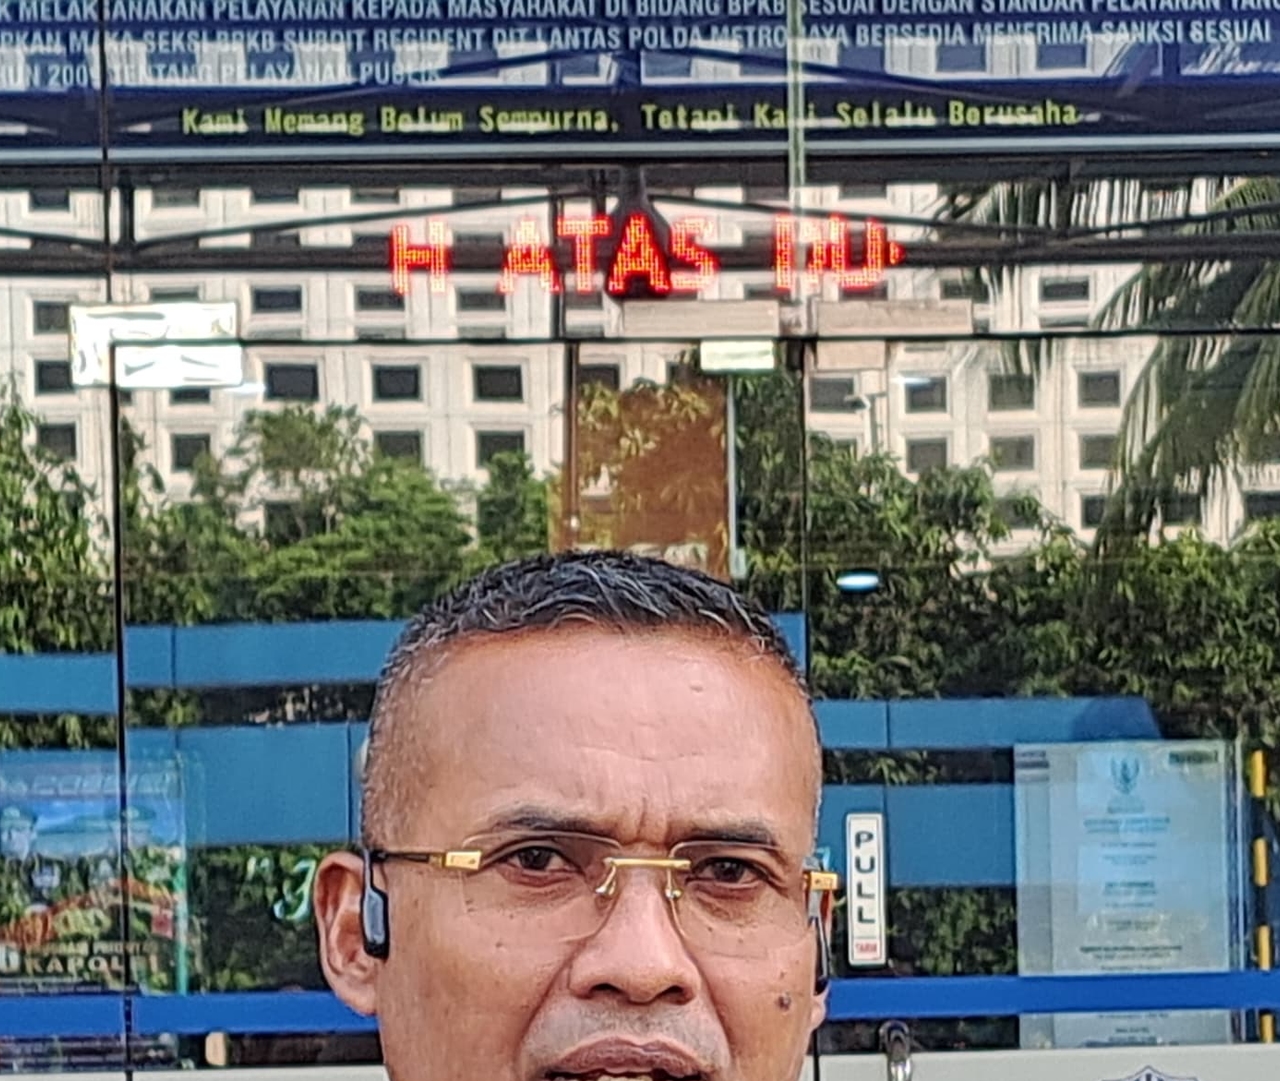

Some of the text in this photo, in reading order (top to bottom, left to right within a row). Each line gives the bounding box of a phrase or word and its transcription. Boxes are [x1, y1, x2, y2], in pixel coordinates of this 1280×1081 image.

[213, 0, 345, 21] PELAYANAN
[353, 0, 440, 20] KEPADA
[537, 27, 619, 51] LANTAS
[629, 26, 701, 50] POLDA
[856, 23, 967, 47] BERSEDIA
[1102, 20, 1183, 44] SANKSI
[499, 213, 718, 294] ATAS
[854, 830, 877, 925] PULL
